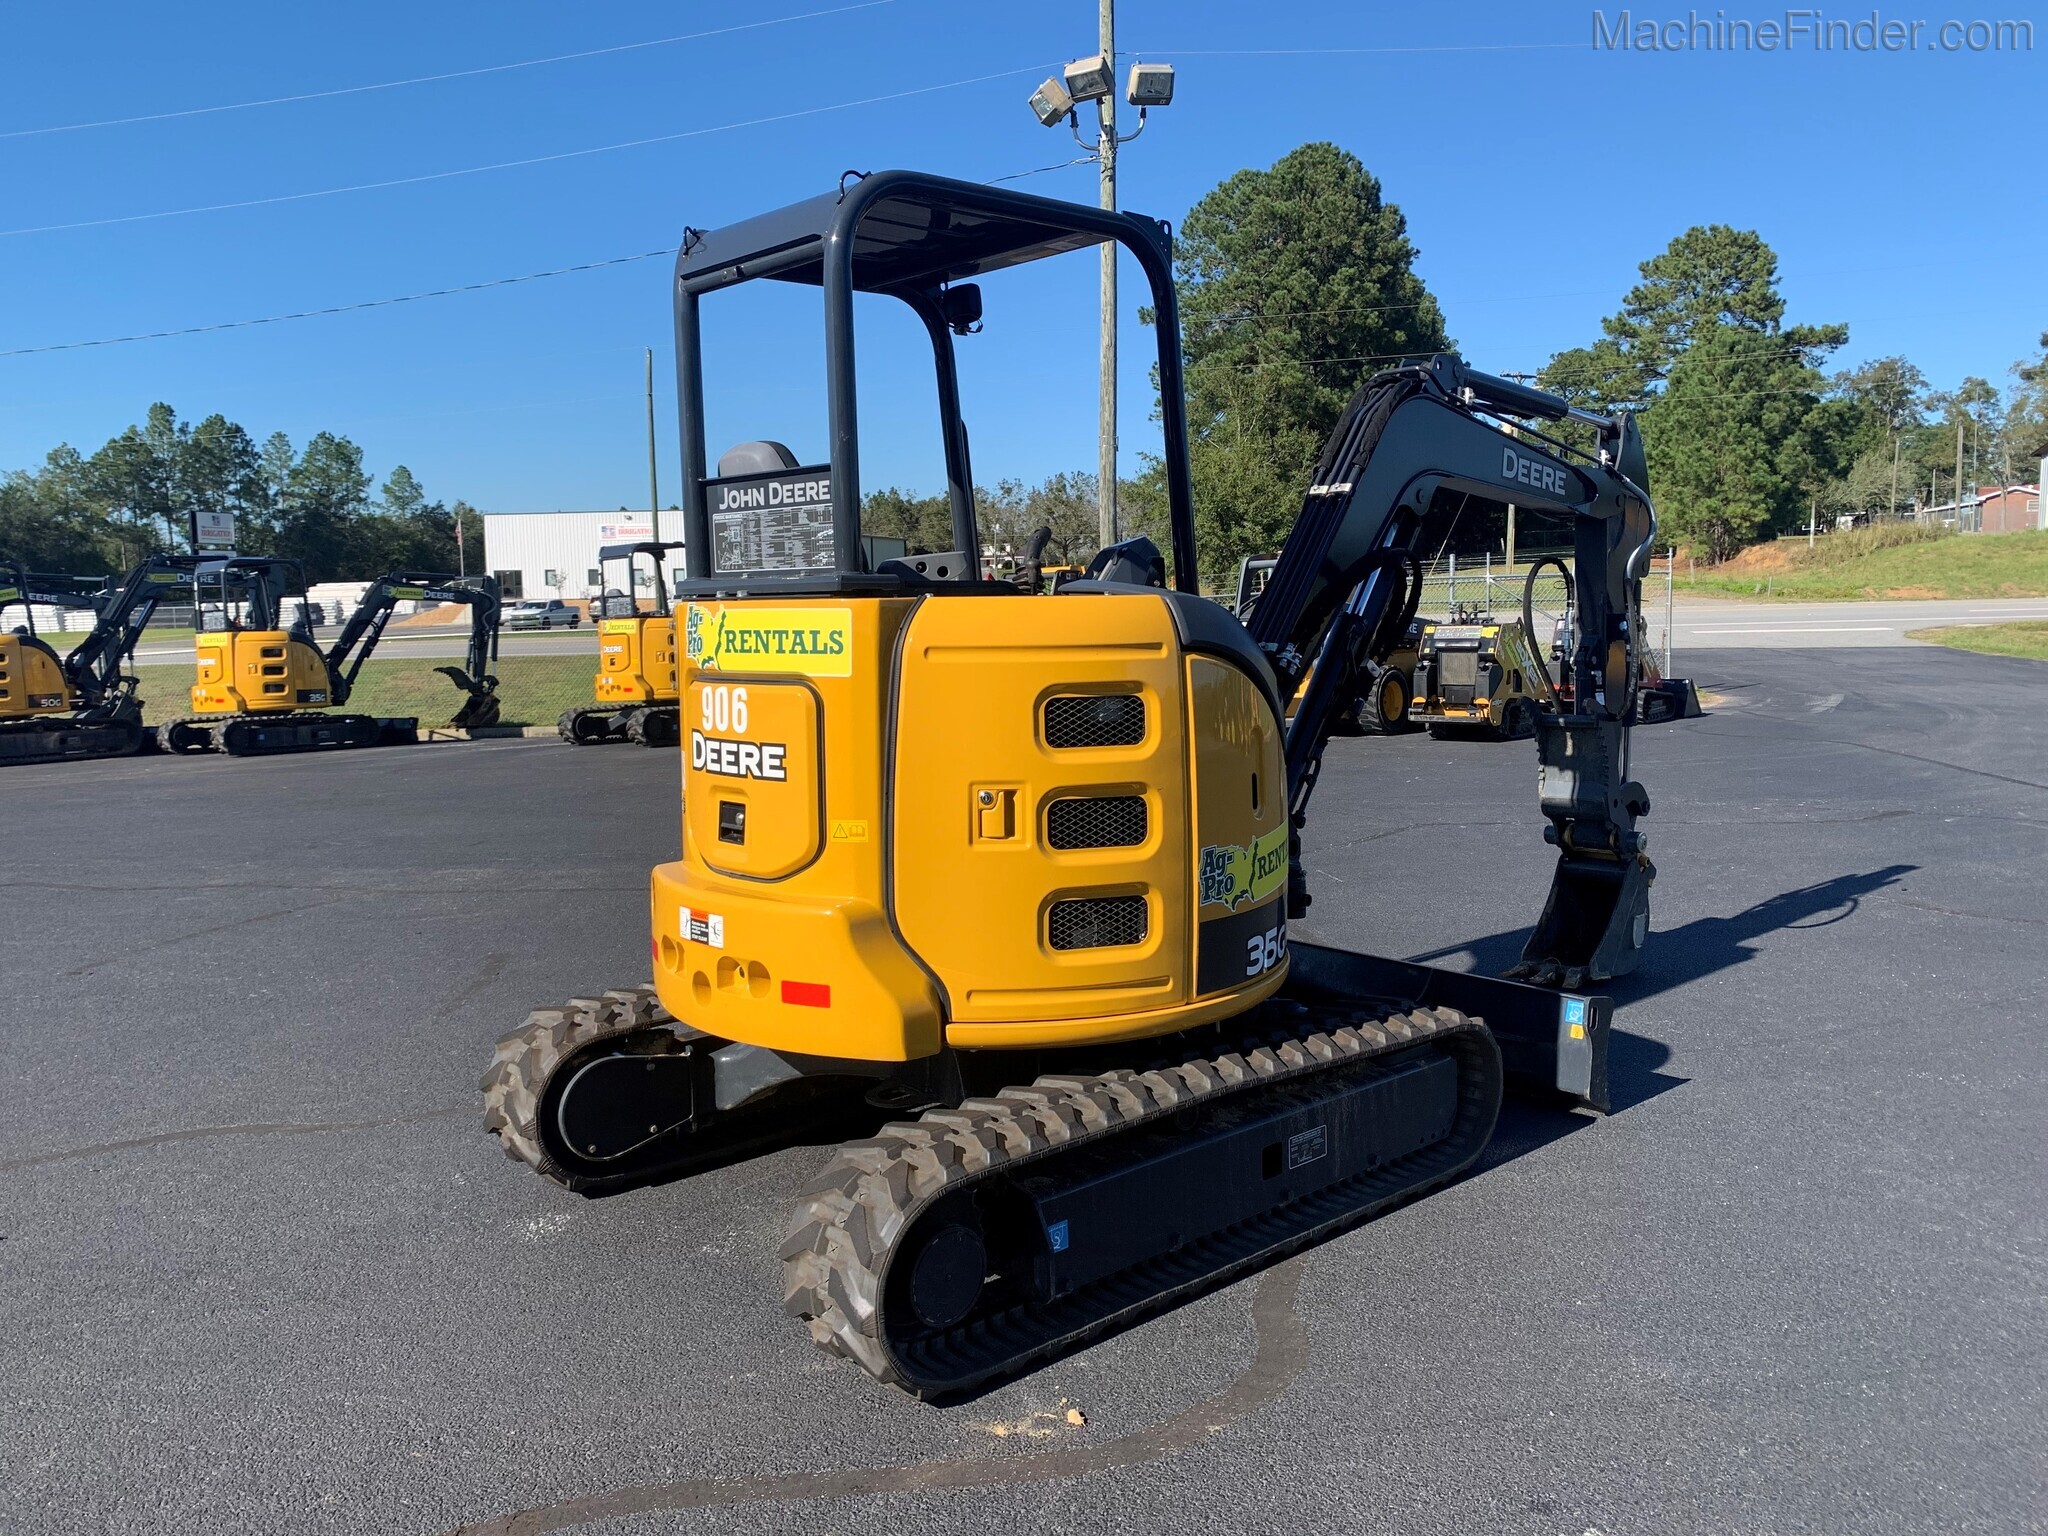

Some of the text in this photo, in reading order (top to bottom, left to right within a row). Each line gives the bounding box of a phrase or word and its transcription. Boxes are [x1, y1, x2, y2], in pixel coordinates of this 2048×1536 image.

[1502, 447, 1567, 496] DEERE
[719, 479, 831, 510] JOHN DEERE
[424, 589, 455, 600] DEERE
[724, 629, 844, 655] RENTALS
[701, 685, 748, 734] 906
[691, 729, 787, 781] DEERE
[1202, 846, 1235, 877] Ag-
[1257, 840, 1288, 880] RENT
[1202, 873, 1236, 904] Pro
